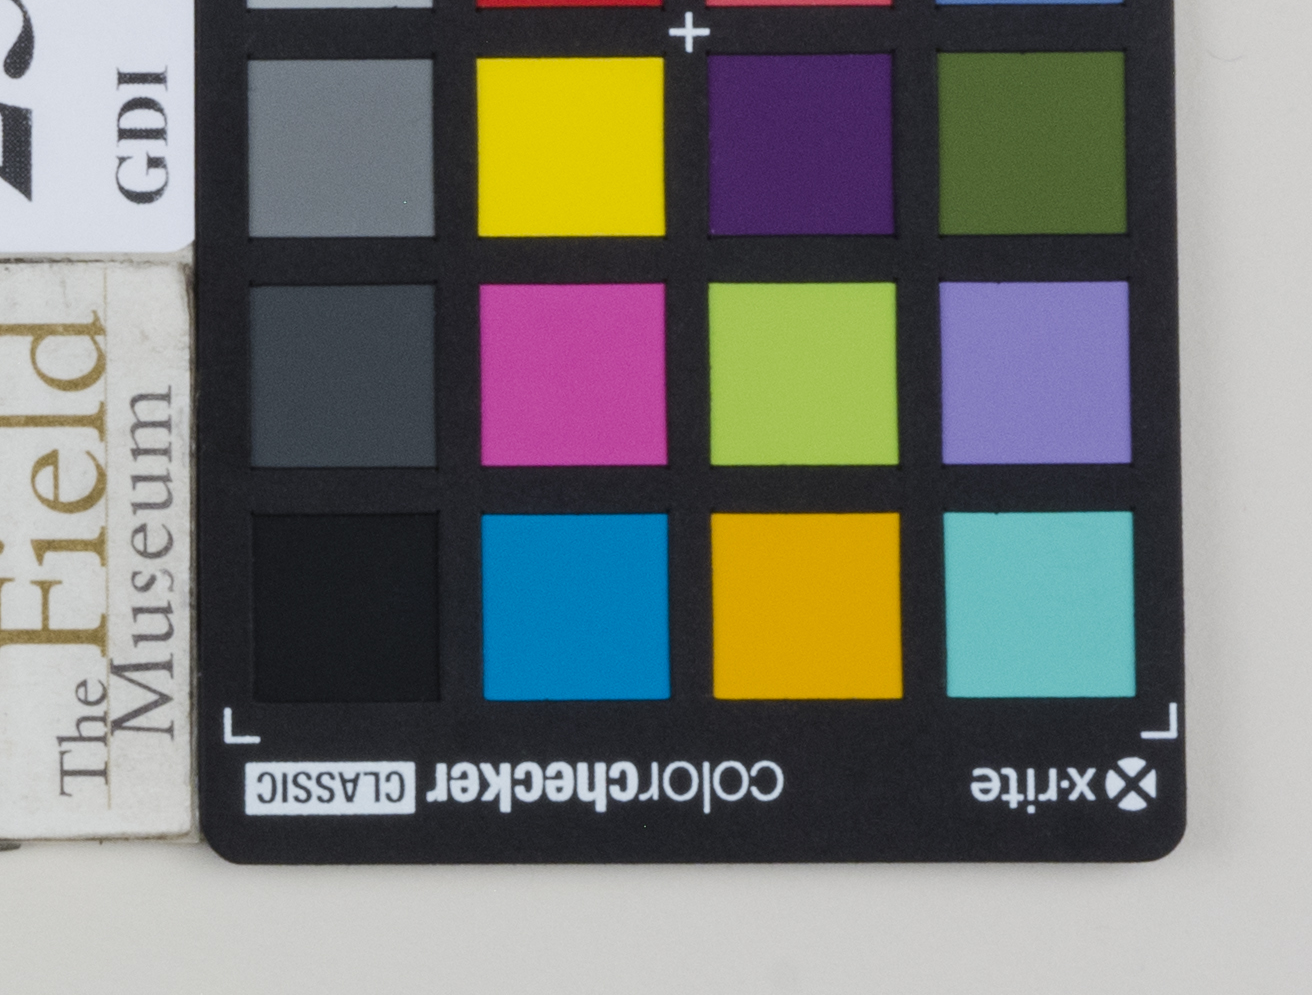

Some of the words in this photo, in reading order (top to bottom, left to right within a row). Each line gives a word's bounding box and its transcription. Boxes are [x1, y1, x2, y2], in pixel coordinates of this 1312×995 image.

[115, 68, 169, 205] GDI
[109, 385, 175, 741] Museum
[56, 678, 109, 797] The
[256, 770, 406, 804] CLASSIC
[425, 760, 784, 814] colorchecker
